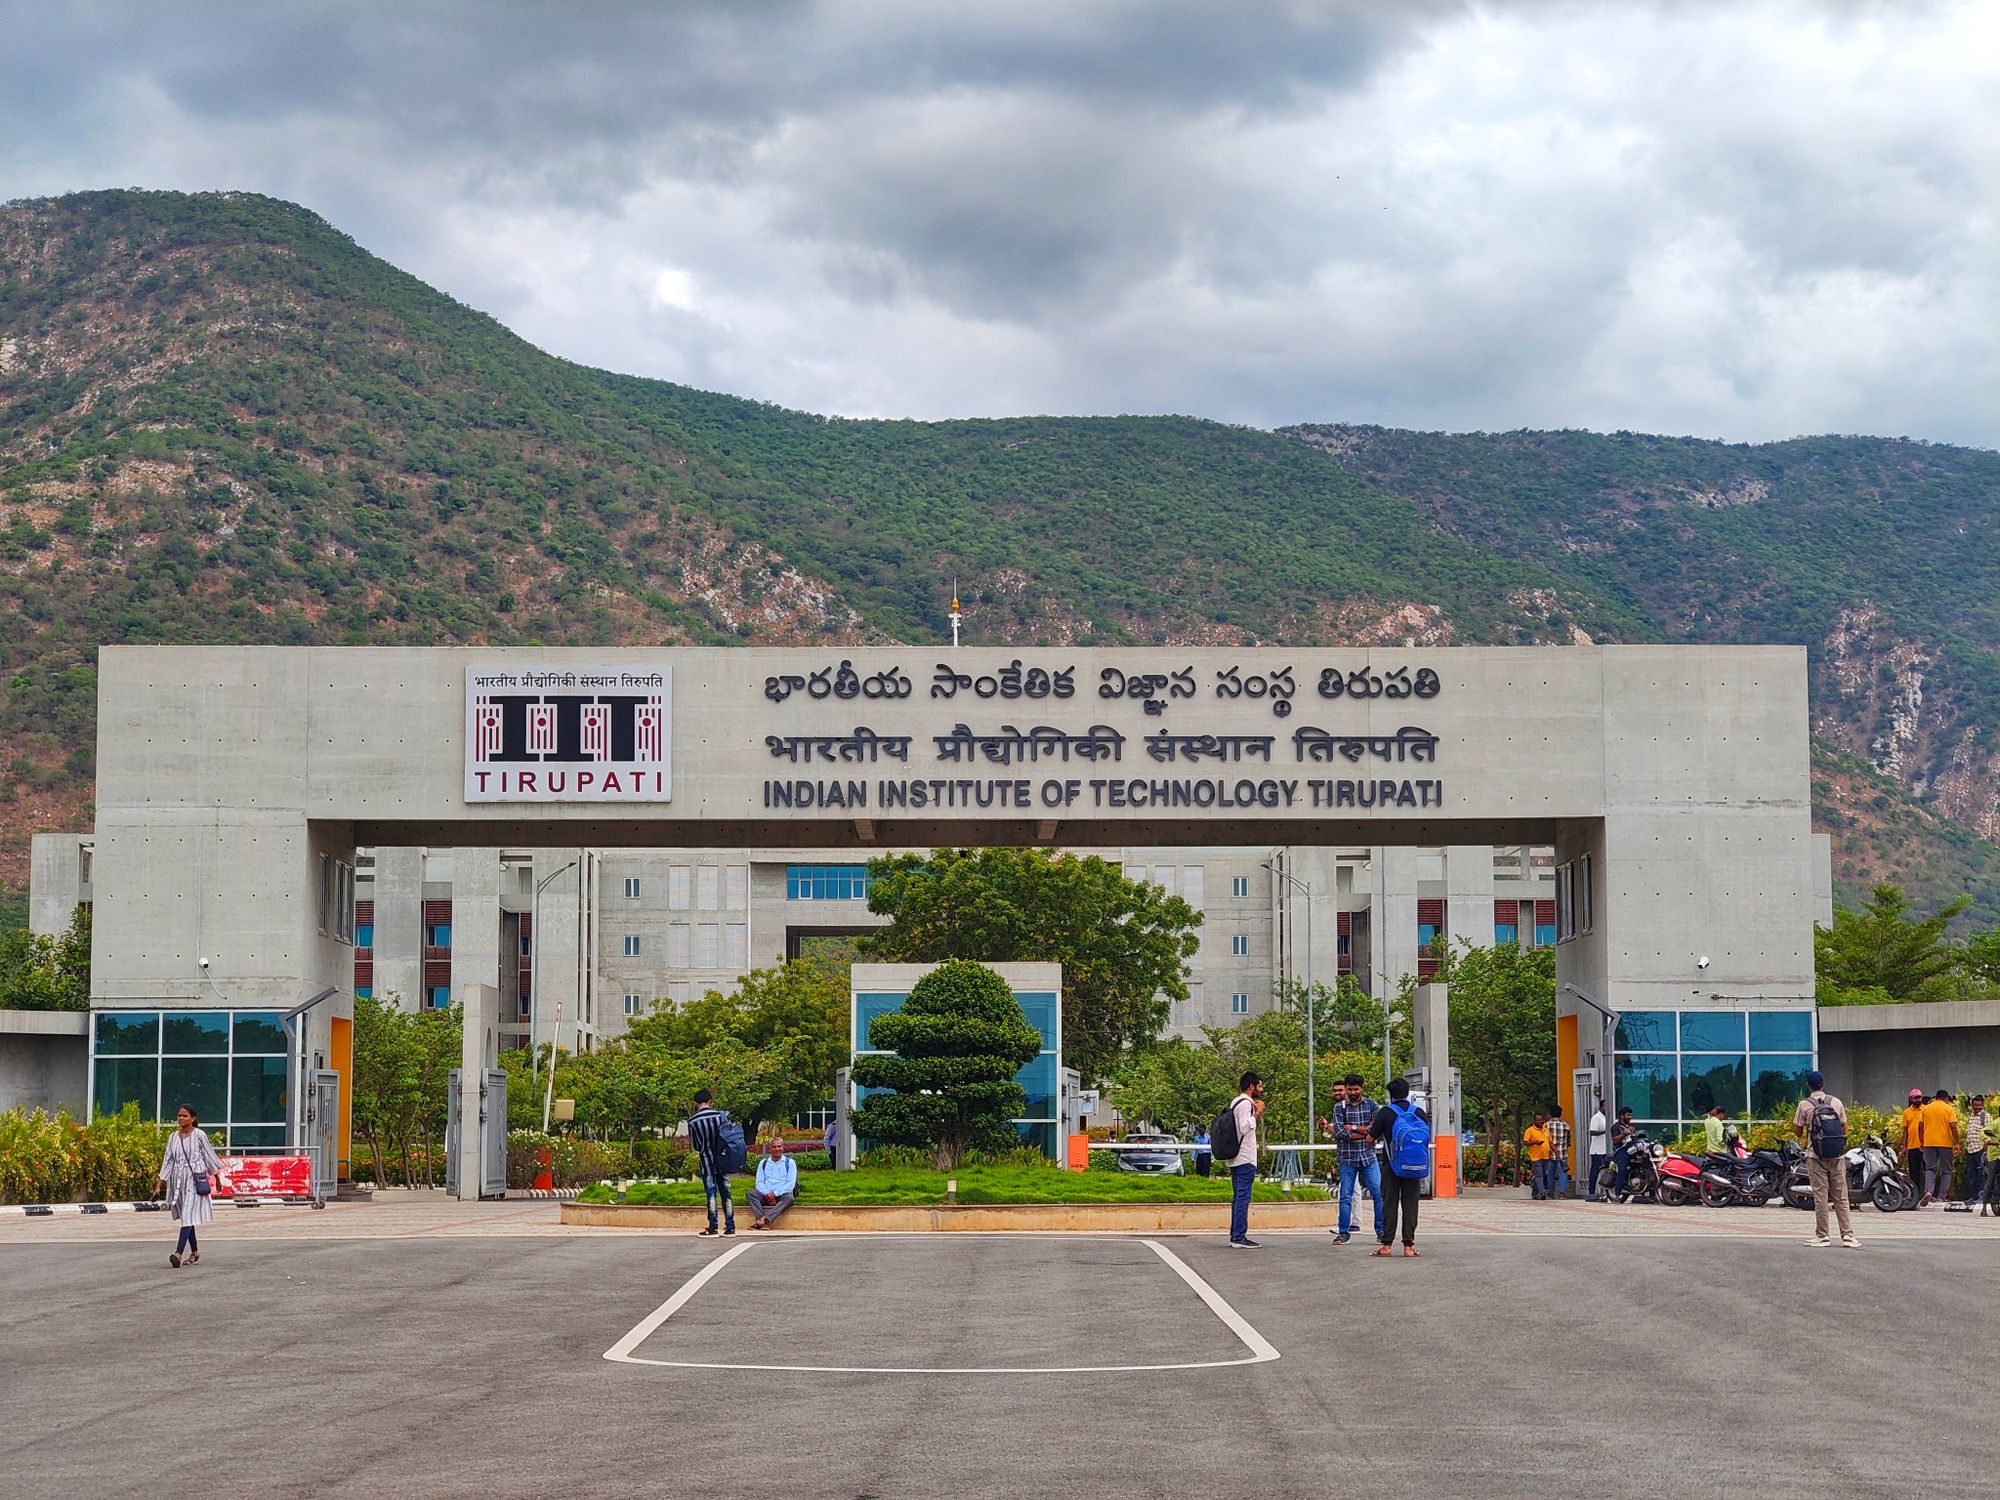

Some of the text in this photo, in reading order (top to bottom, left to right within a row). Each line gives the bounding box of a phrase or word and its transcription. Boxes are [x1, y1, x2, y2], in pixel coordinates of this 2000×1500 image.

[474, 671, 664, 689] भारतीय प्रौद्योगिकी संस्थान तिरुपति
[764, 659, 1441, 718] భారతీయ సాంకేతిక విజ్ఞాన సంస్థ తిరుపతి
[489, 695, 649, 762] IIT
[764, 723, 1441, 765] भारतीय प्रौद्योगिकी संस्थान तिरुपति
[474, 771, 662, 793] TIRUPATI
[764, 778, 1442, 808] INDIAN INSTITUTE OF TECHNOLOGY TIRUPATI
